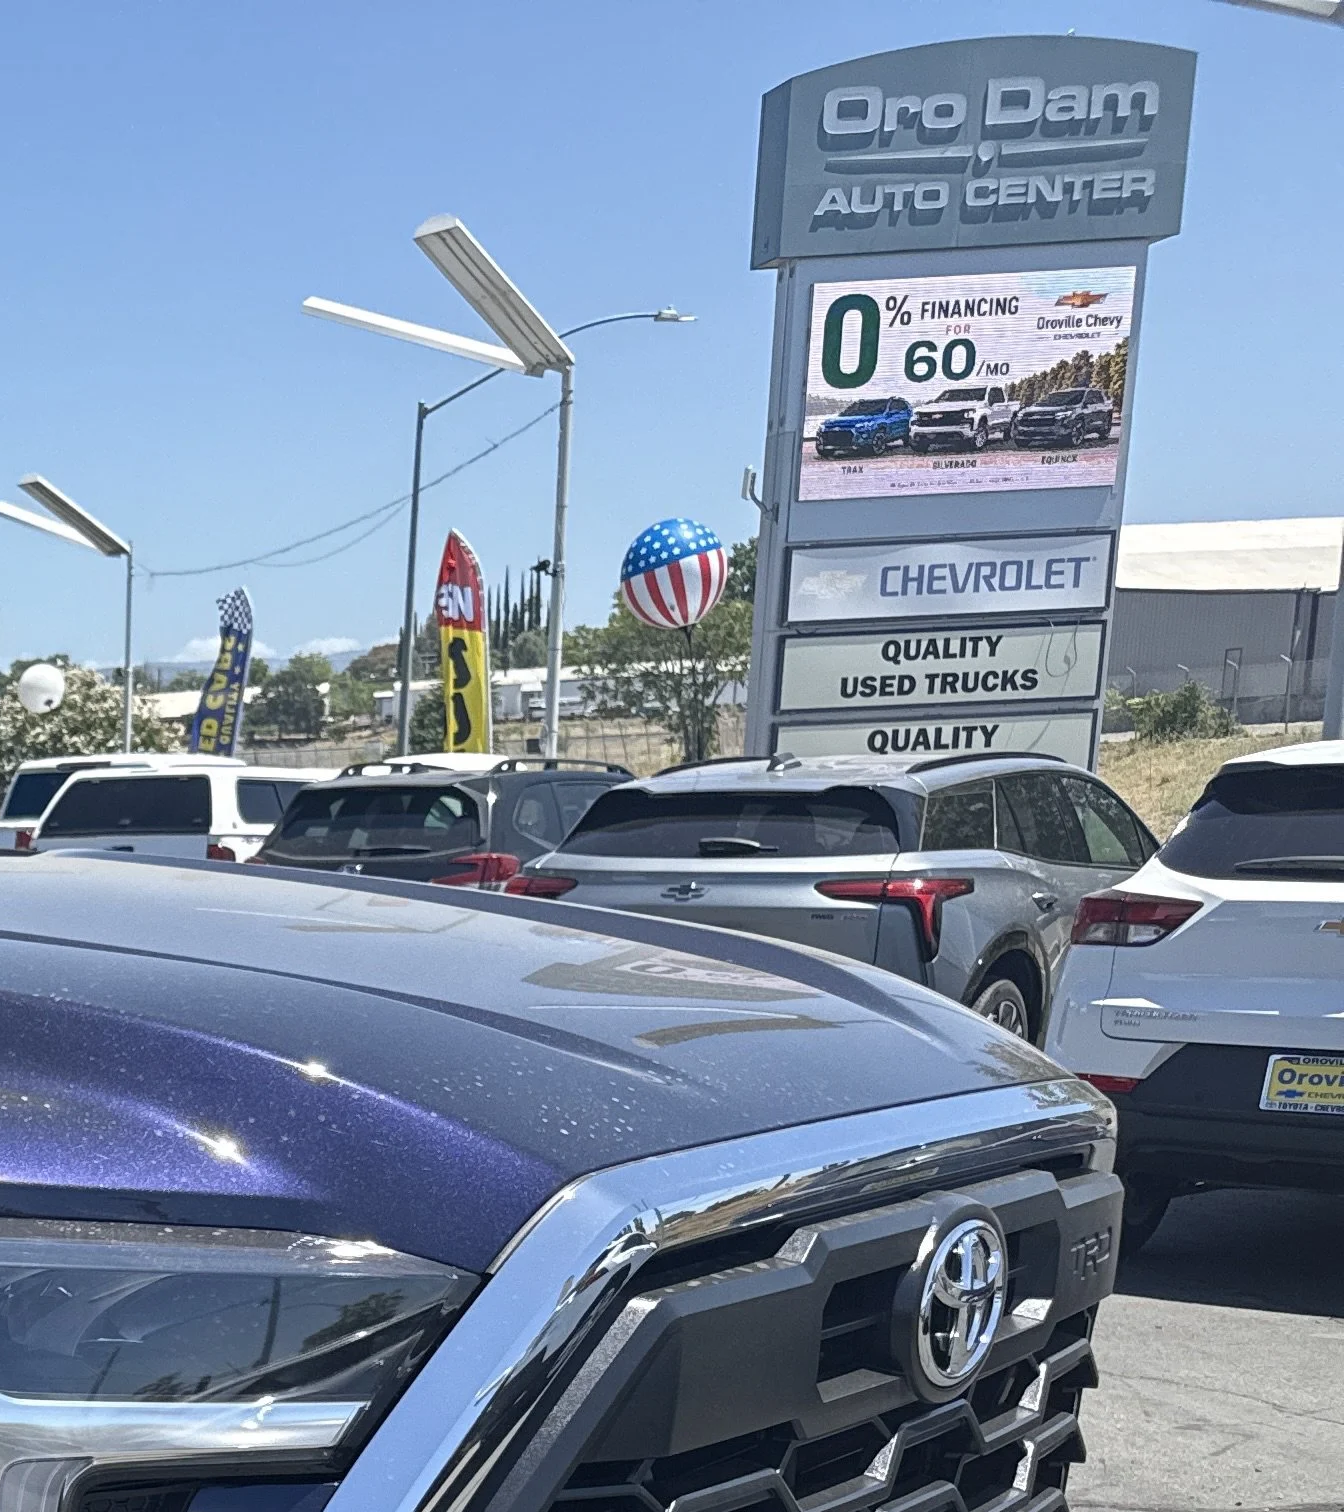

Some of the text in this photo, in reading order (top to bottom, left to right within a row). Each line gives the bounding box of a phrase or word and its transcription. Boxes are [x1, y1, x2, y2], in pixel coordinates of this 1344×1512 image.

[822, 76, 1160, 135] Oro Dam
[813, 168, 1156, 216] AUTO CENTER
[920, 296, 1020, 320] FINANCING
[1036, 314, 1123, 330] Oroville Chevy
[945, 324, 972, 336] FOR
[841, 465, 864, 476] TRAX
[932, 459, 977, 470] SILVERADO
[879, 556, 1092, 598] CHEVROLET
[880, 634, 1005, 664] QUALITY
[840, 668, 1039, 700] USED TRUCKS
[867, 724, 1000, 755] QUALITY
